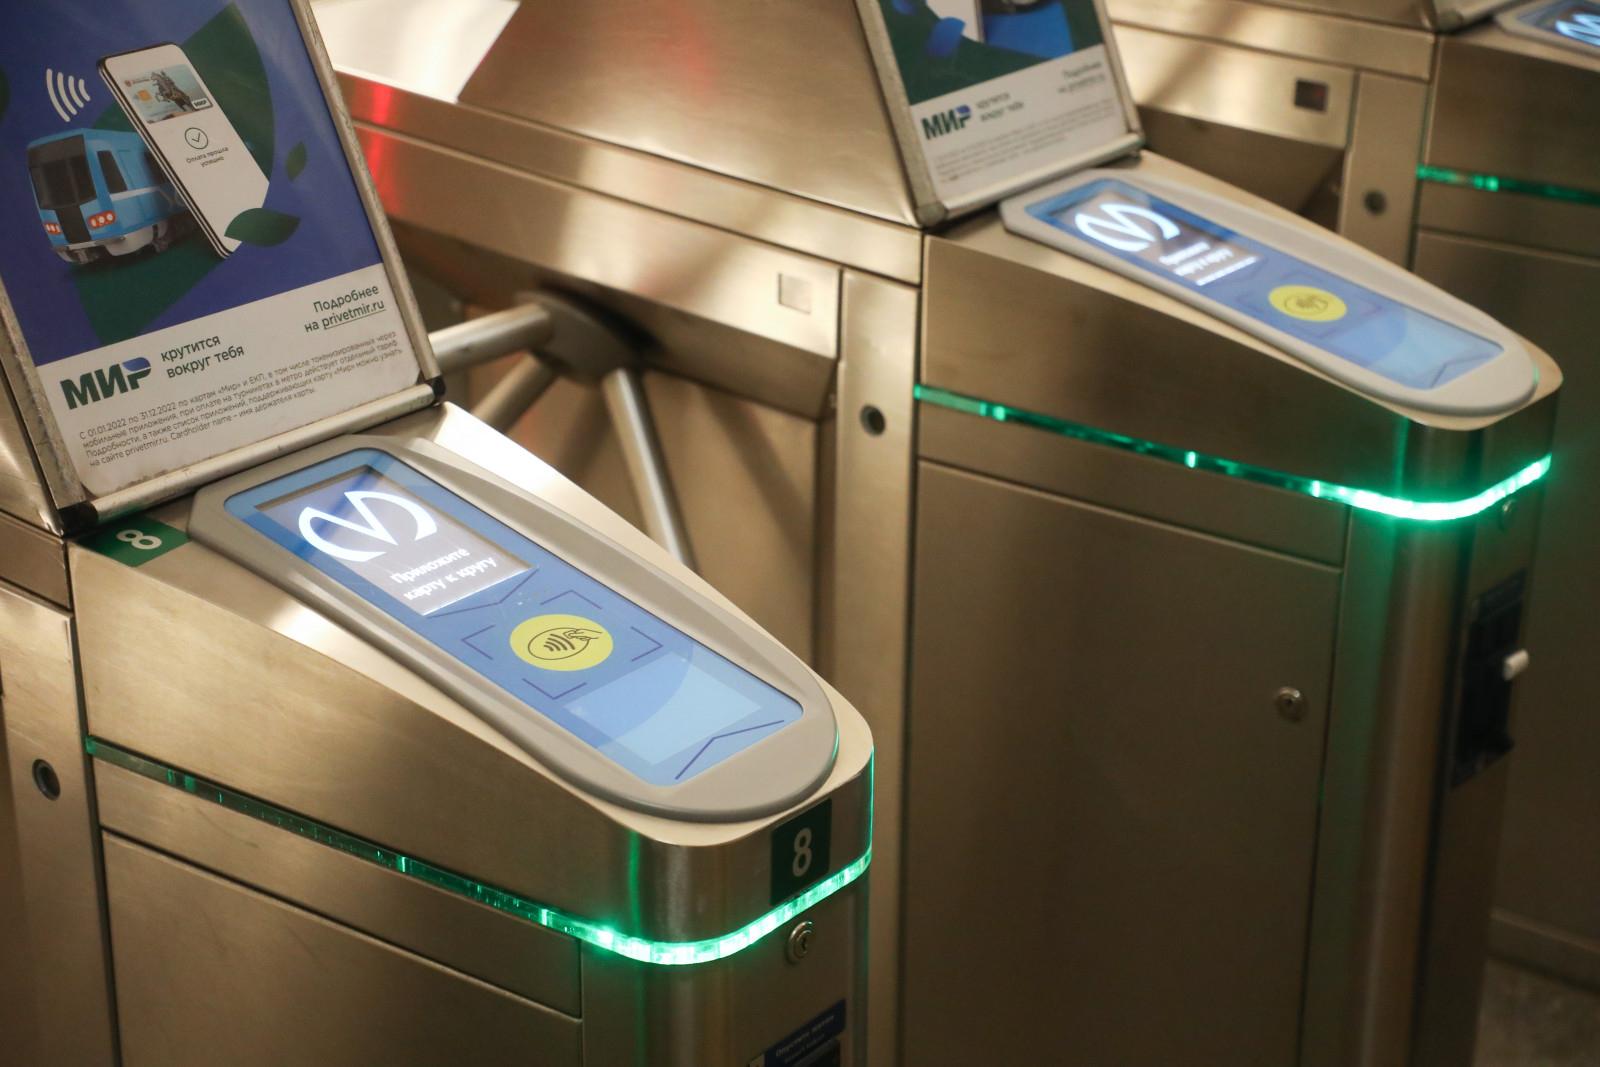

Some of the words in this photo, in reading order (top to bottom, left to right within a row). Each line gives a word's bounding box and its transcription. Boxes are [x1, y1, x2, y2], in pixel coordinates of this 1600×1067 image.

[921, 104, 972, 140] МИР
[304, 321, 319, 333] на
[321, 300, 385, 330] privetmir.ru
[313, 286, 379, 313] Подробнее
[160, 335, 221, 362] крутится
[166, 356, 211, 379] вокруг
[214, 345, 245, 363] тебя
[60, 356, 151, 410] МИР
[179, 408, 195, 418] при
[196, 400, 222, 412] оплате
[281, 372, 303, 383] метро
[88, 418, 127, 438] 01.01.2022
[128, 415, 139, 424] по
[140, 401, 177, 420] 31.12.2022
[178, 399, 189, 408] по
[190, 391, 216, 404] картам
[149, 425, 172, 438] также
[173, 417, 200, 430] список
[101, 450, 125, 464] сайте
[212, 416, 232, 426] name
[115, 529, 162, 550] 8
[390, 548, 470, 584] Приложите
[403, 579, 447, 601] карту
[445, 574, 459, 583] к
[456, 557, 497, 578] кругу
[792, 827, 813, 877] 8
